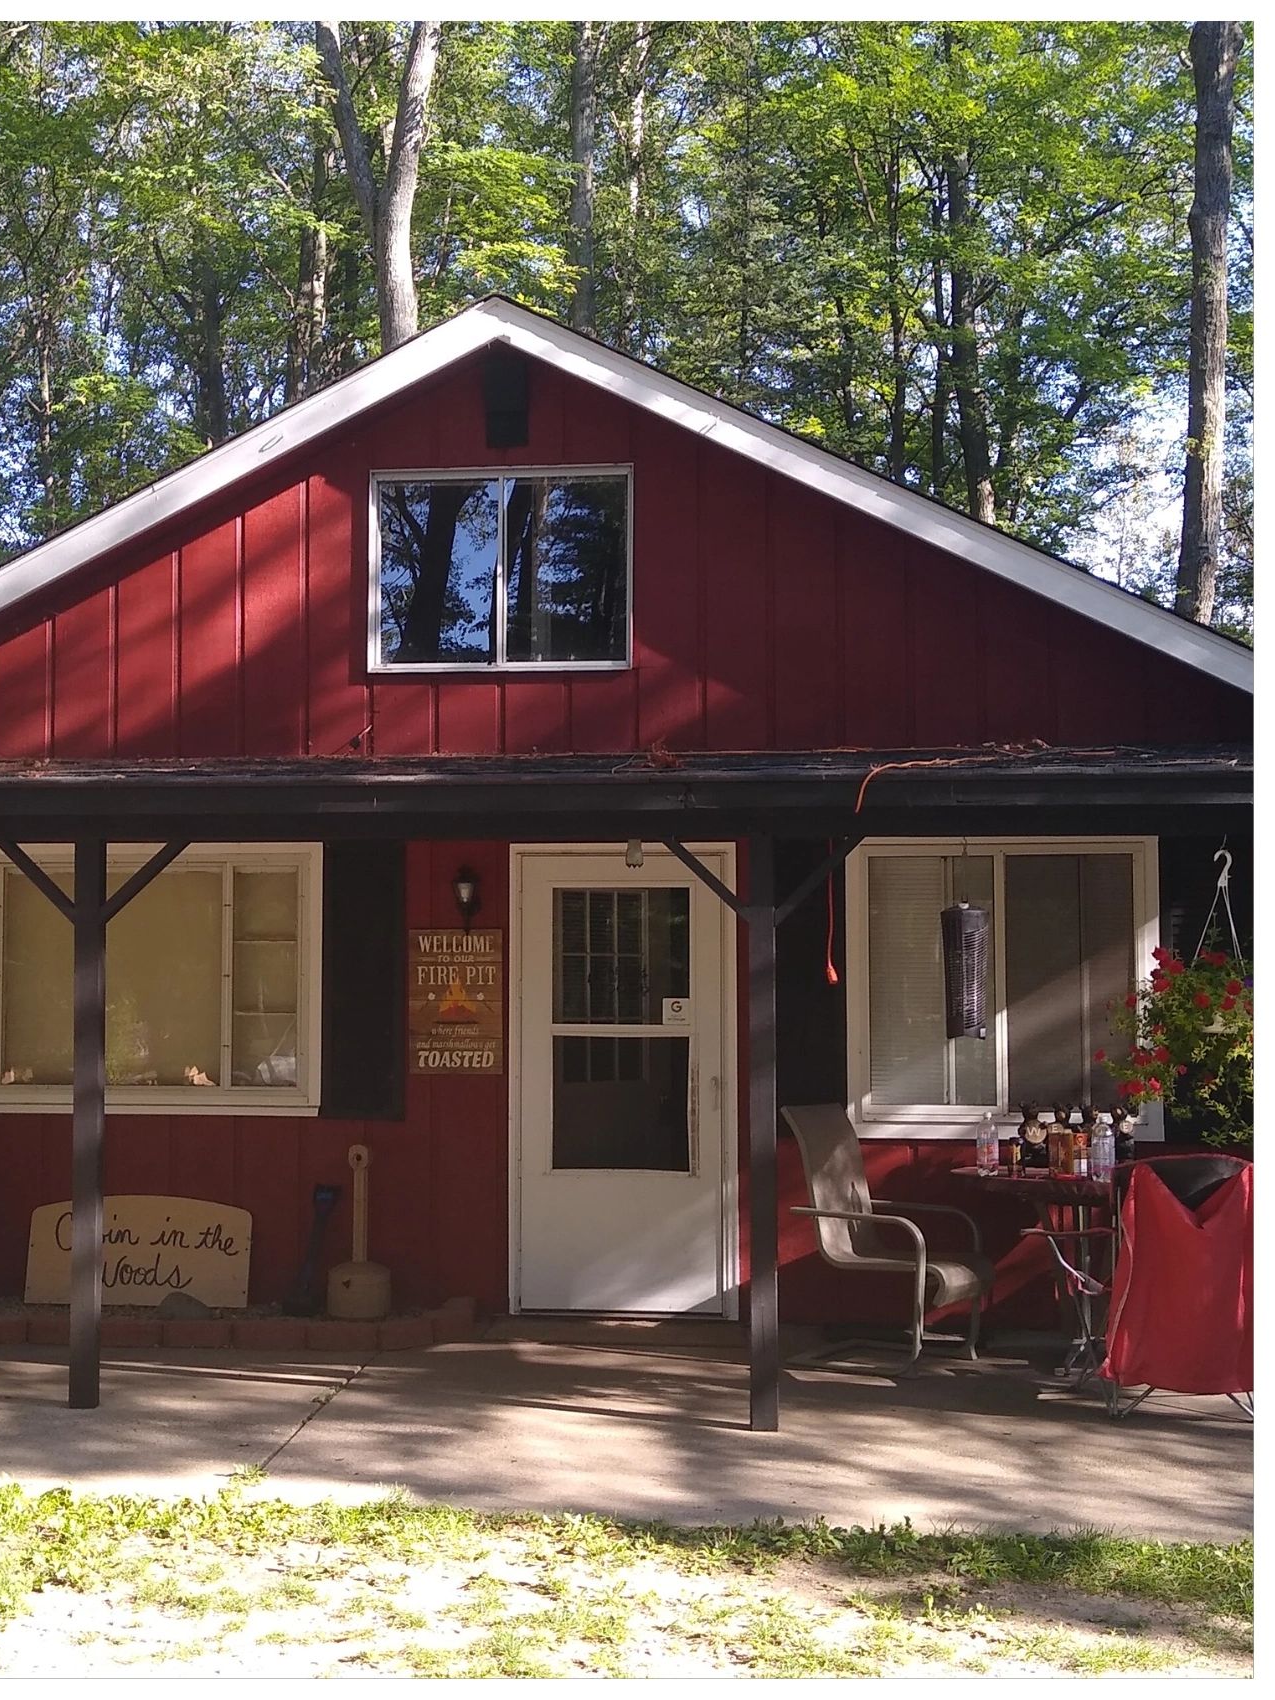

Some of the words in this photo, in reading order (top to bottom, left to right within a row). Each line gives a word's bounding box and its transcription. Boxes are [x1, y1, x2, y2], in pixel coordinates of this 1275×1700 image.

[418, 935, 495, 953] WELCOME
[437, 955, 450, 963] TO
[453, 954, 475, 963] OUR
[416, 965, 460, 985] FIRE
[465, 965, 496, 985] PIT
[670, 1000, 682, 1013] G
[431, 1024, 453, 1035] where
[452, 1023, 479, 1037] friends
[416, 1038, 432, 1049] and
[432, 1038, 483, 1050] marshmallows
[418, 1050, 495, 1068] TOASTED
[1026, 1126, 1041, 1136] W
[55, 1211, 139, 1251] Cin
[150, 1216, 190, 1249] in
[194, 1223, 239, 1256] the
